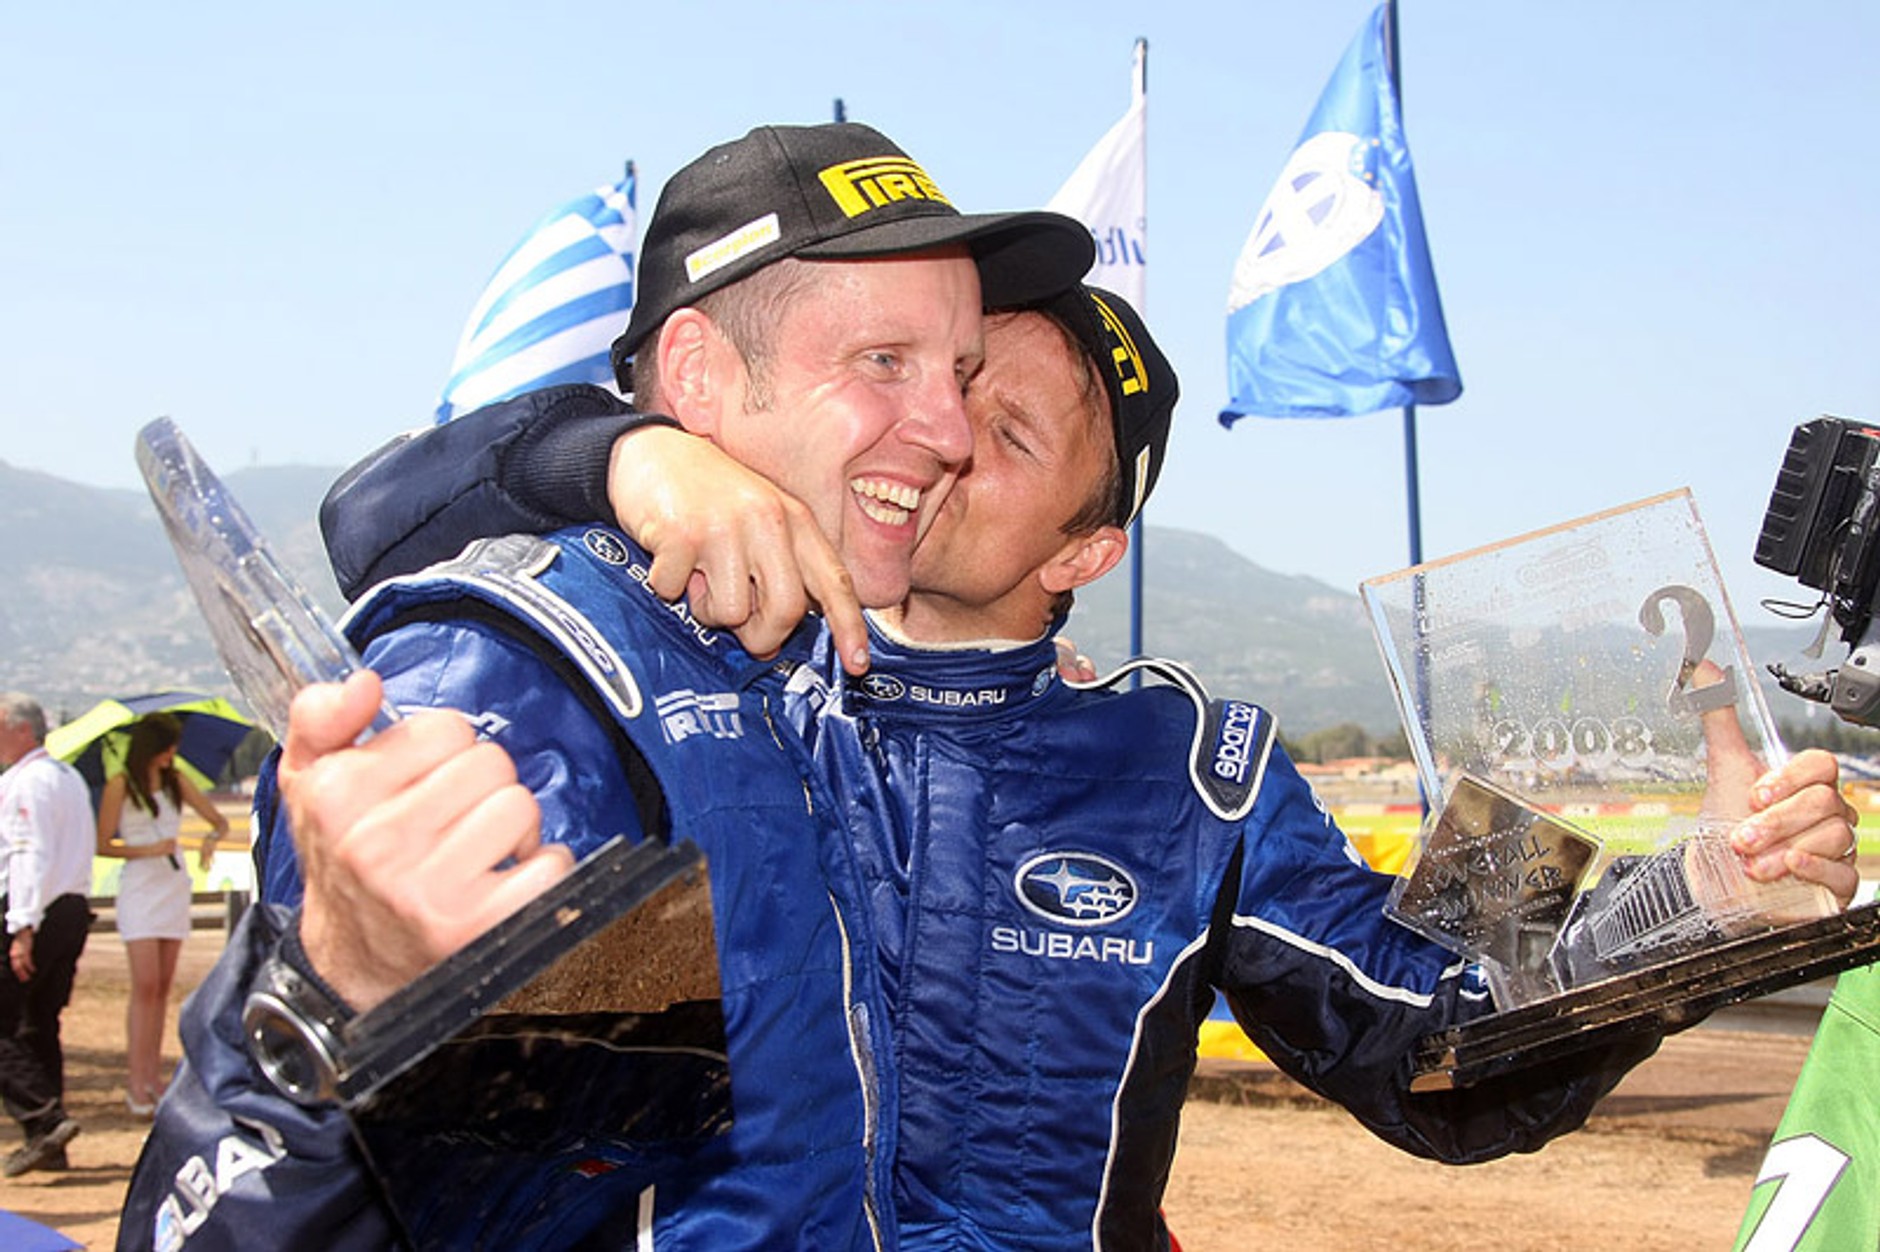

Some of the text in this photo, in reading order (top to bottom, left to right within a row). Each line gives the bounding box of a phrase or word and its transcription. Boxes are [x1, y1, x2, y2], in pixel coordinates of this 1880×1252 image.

[1639, 584, 1739, 720] 2
[910, 685, 1006, 707] SUBARU
[1492, 716, 1655, 770] 2008
[991, 927, 1155, 966] SUBARU
